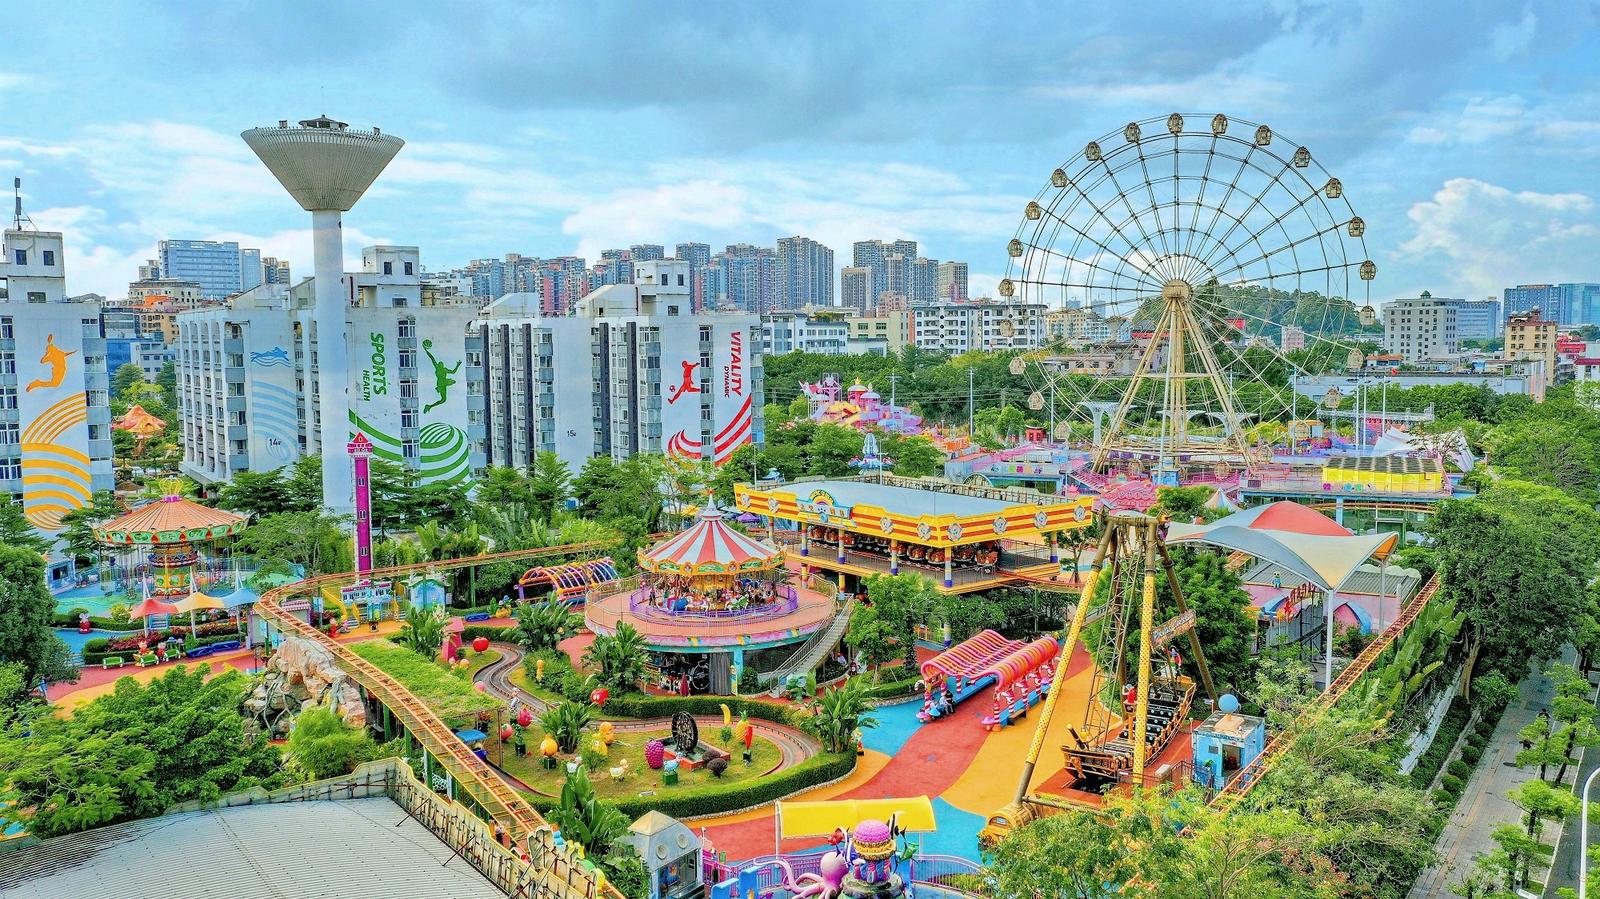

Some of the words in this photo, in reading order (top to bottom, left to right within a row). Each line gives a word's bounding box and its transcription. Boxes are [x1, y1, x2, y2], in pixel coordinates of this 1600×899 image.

[363, 369, 371, 402] HEALTH
[371, 332, 387, 395] SPORTS
[731, 331, 742, 397] VITALITY
